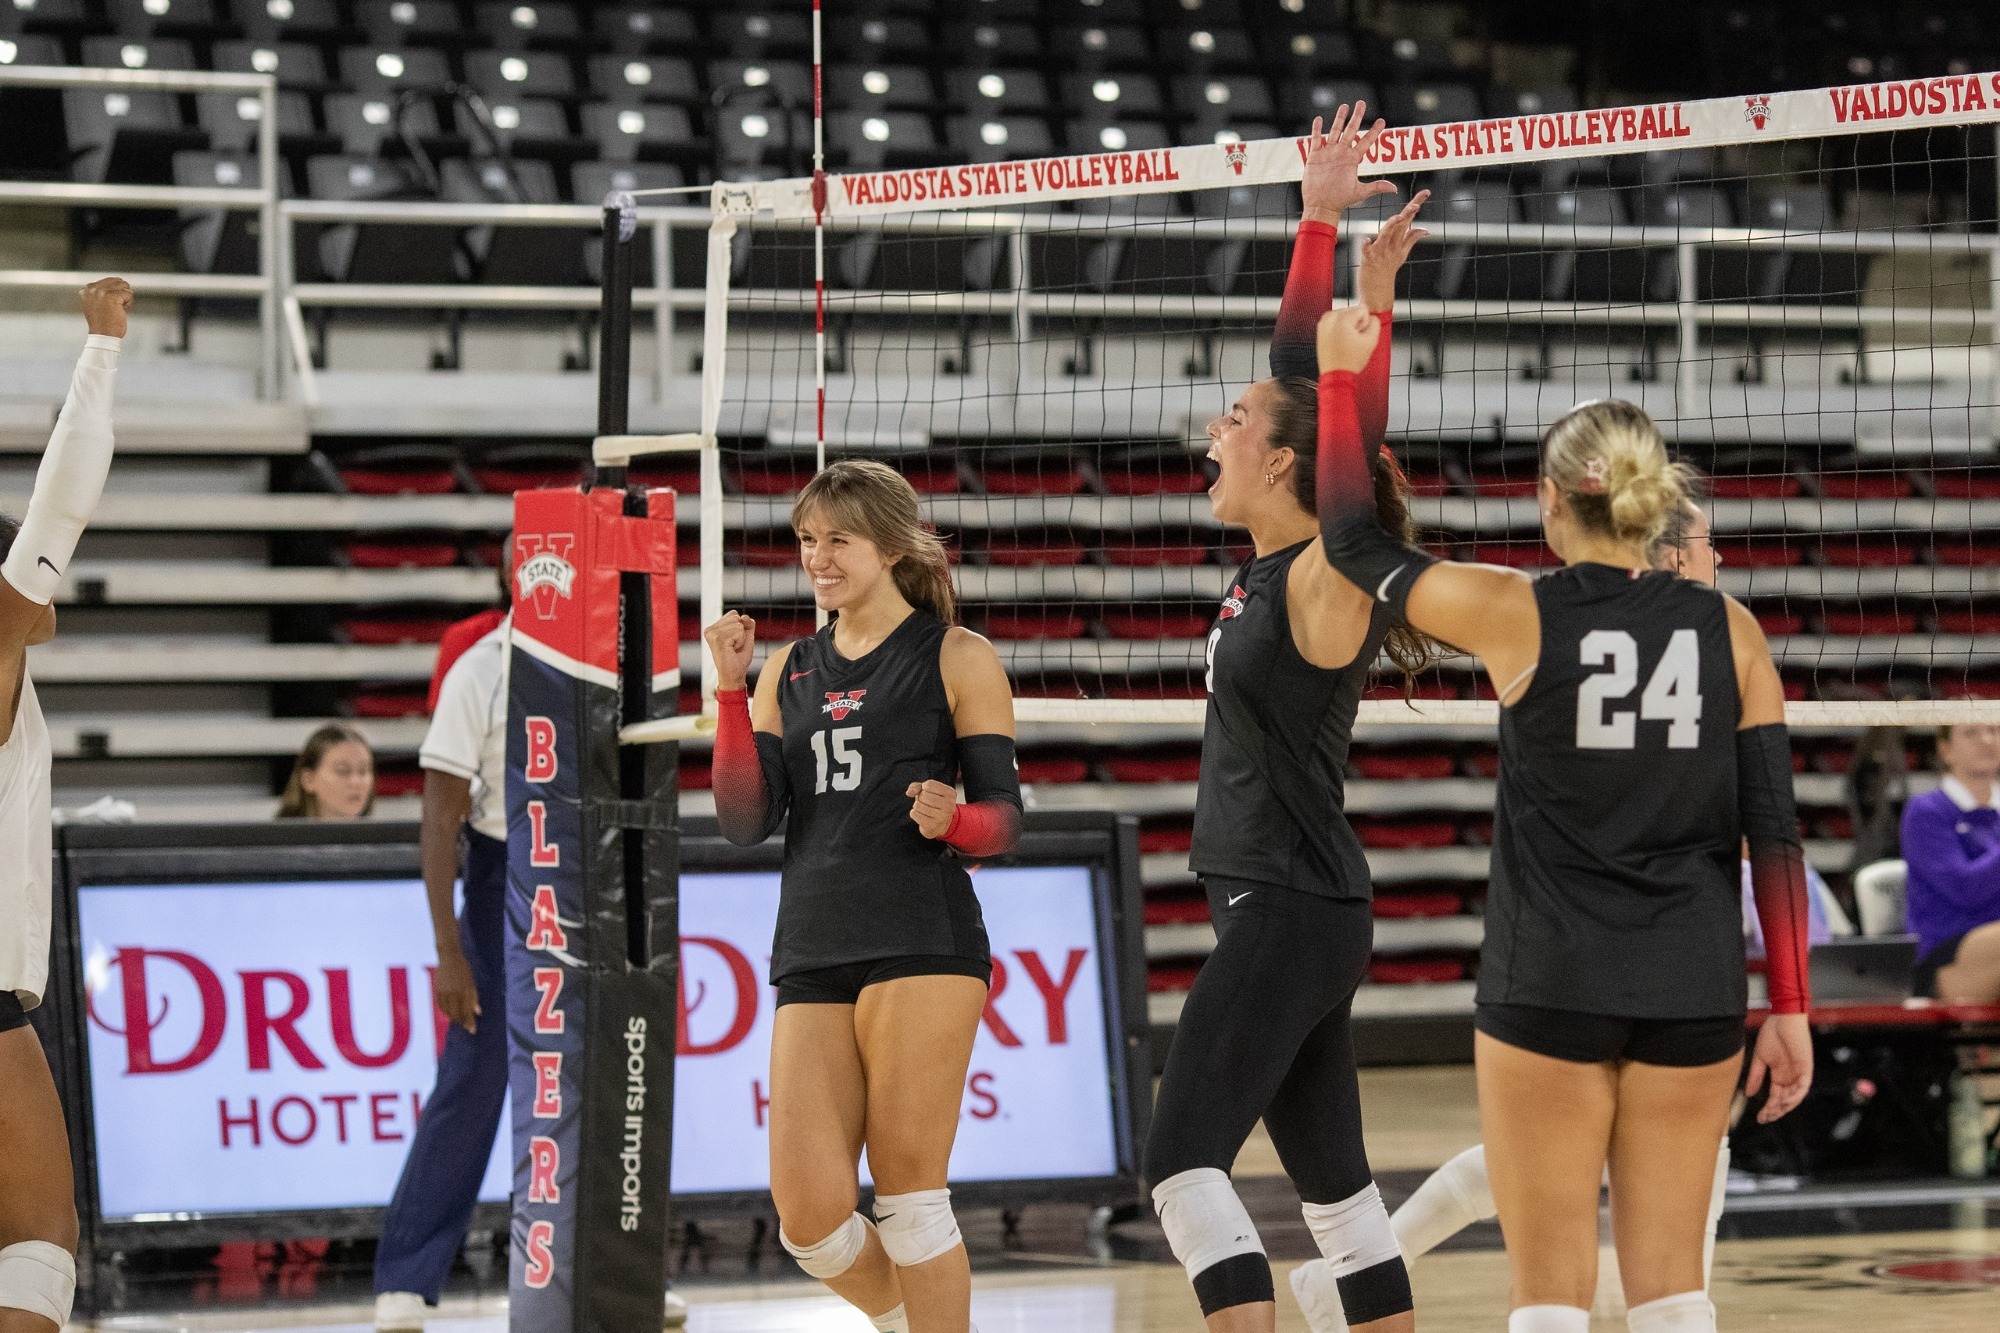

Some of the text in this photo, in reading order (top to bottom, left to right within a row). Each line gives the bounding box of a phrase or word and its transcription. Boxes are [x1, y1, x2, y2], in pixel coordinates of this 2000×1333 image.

[1749, 107, 1768, 116] STATE
[1829, 75, 1987, 123] VALDOSTA
[1228, 153, 1245, 163] STATE
[1433, 119, 1514, 159] STATE
[1517, 103, 1691, 151] VOLLEYBALL
[842, 150, 1180, 206] VALDOSTA STATE VOLLEYBALL
[527, 560, 563, 582] STATE
[830, 700, 856, 709] STATE
[1575, 628, 1704, 750] 24
[810, 726, 863, 796] 15
[524, 716, 568, 1289] BLAZERS
[622, 1015, 648, 1112] sports
